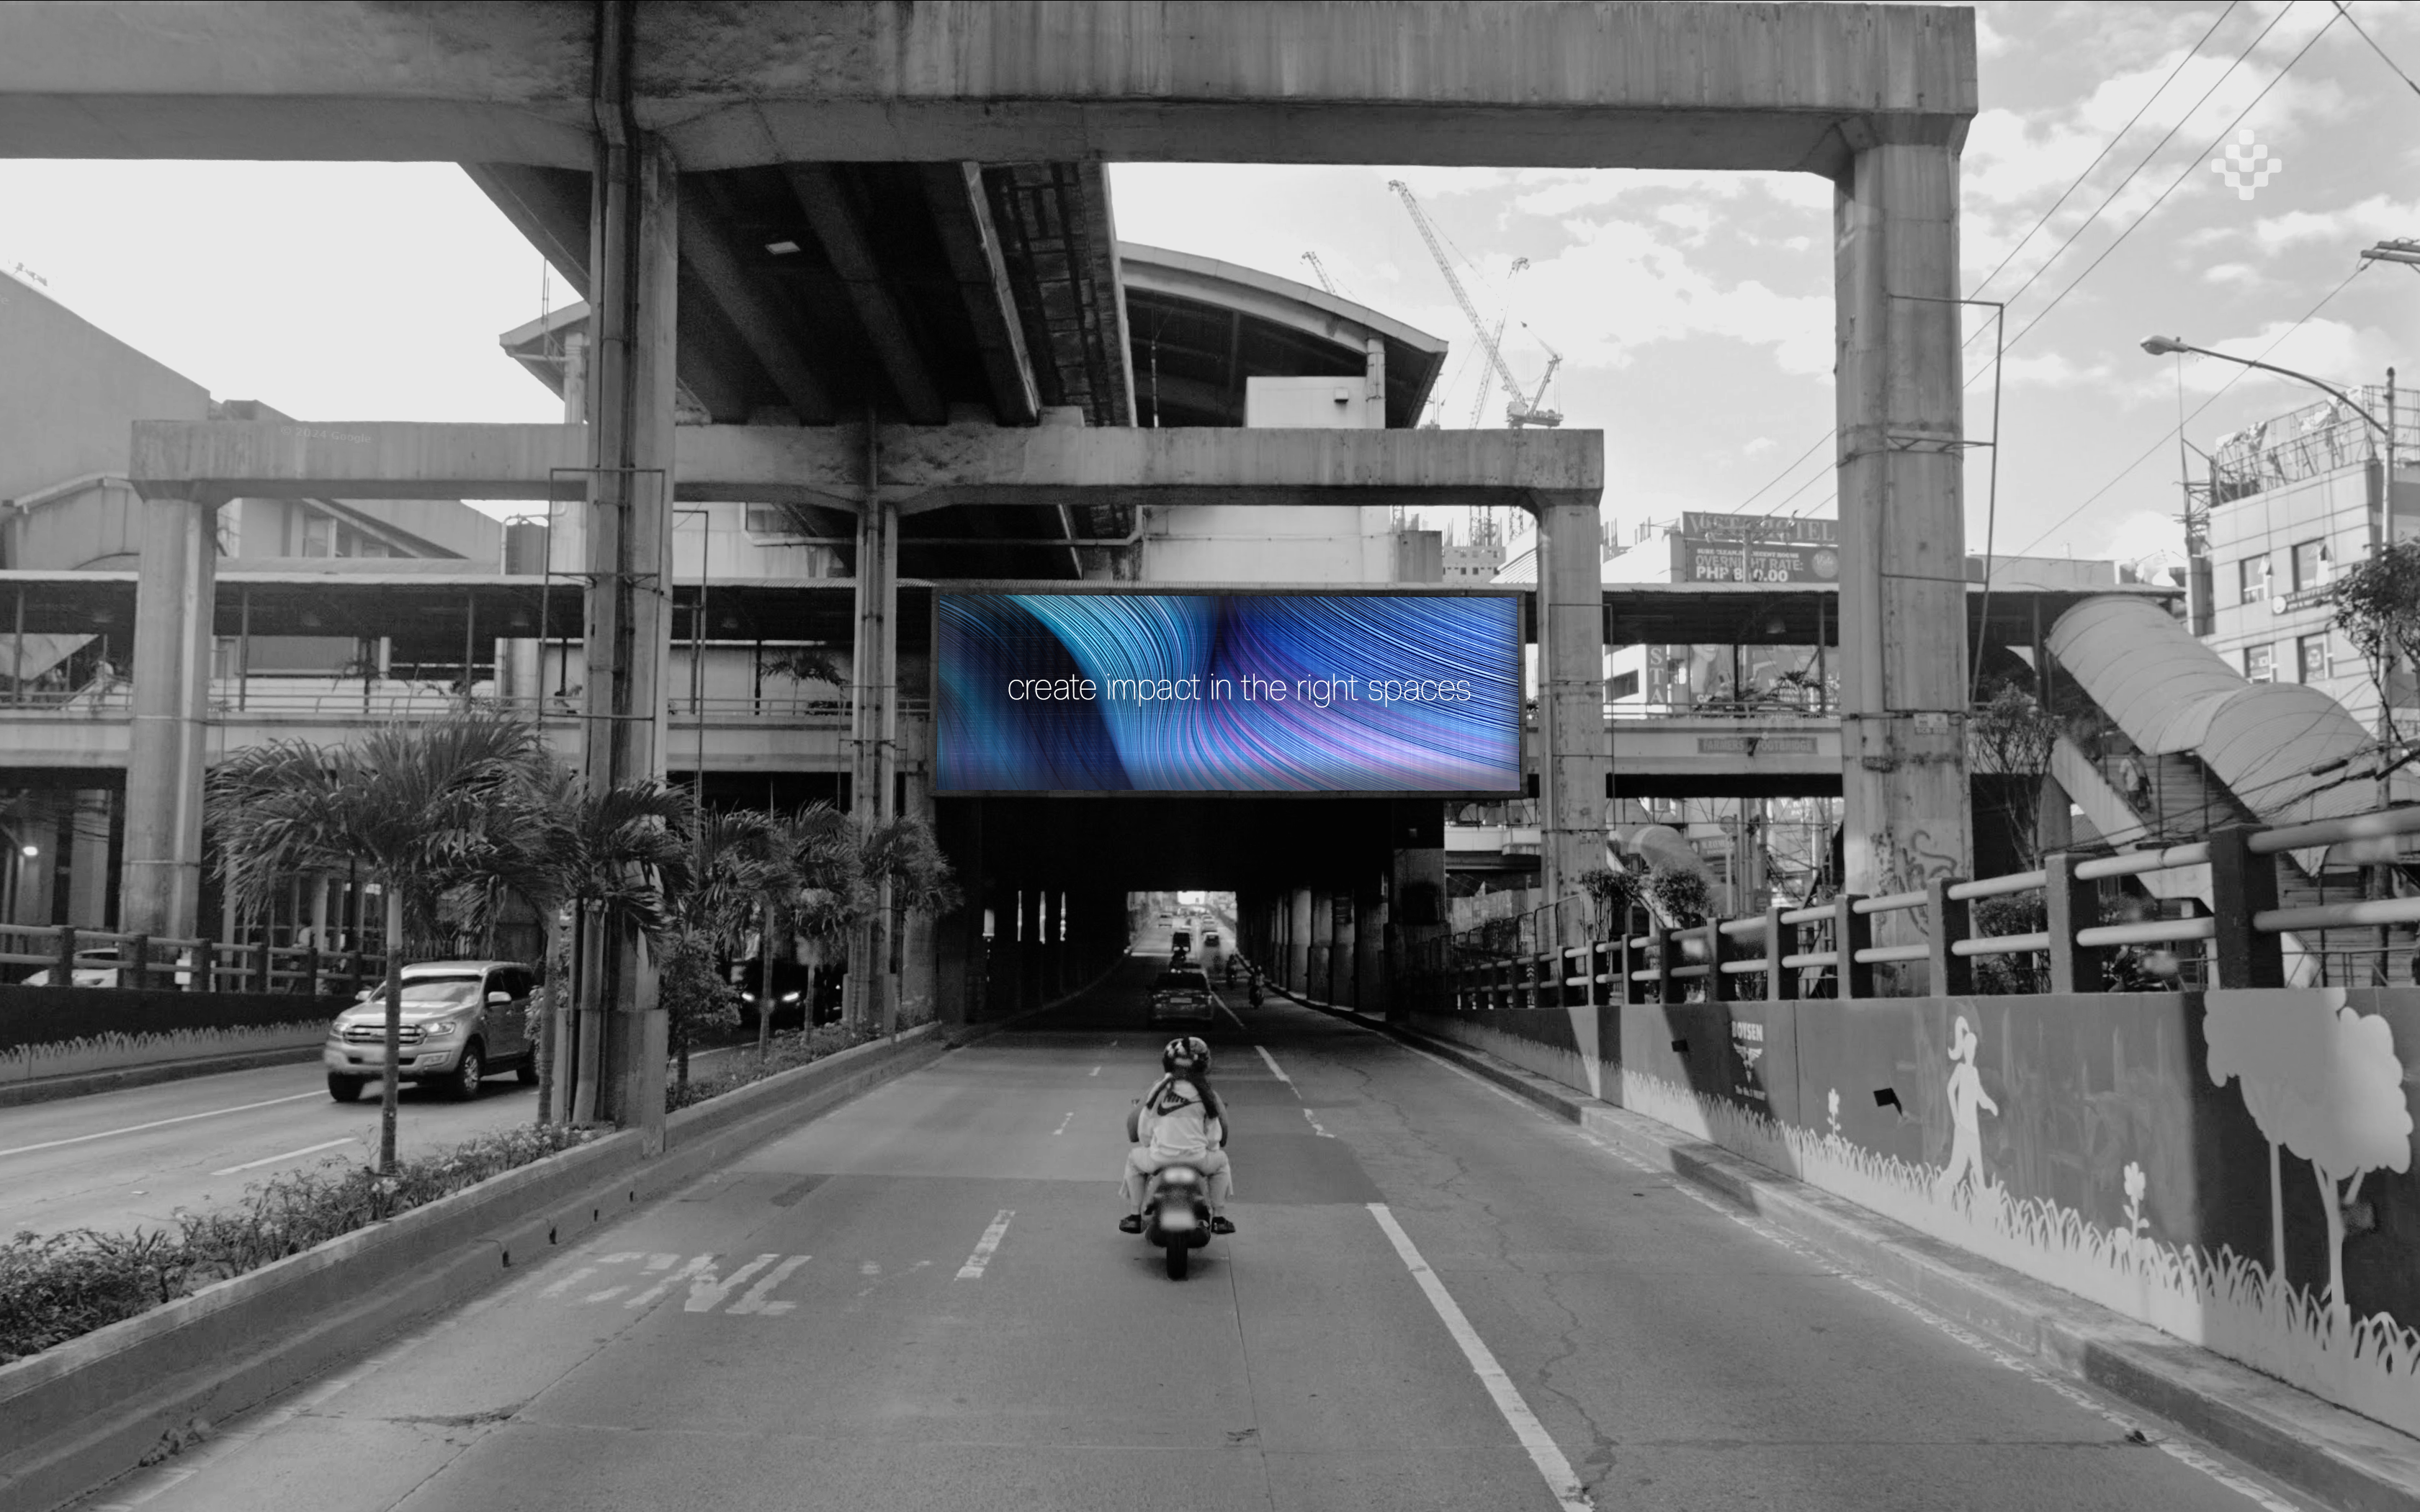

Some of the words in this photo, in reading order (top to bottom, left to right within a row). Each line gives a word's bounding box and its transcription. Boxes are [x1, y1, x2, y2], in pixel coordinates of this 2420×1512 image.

[1688, 514, 1754, 536] VIST
[1695, 555, 1765, 570] OVERNIHT
[1769, 558, 1803, 571] RATE:
[1696, 566, 1729, 579] PHP
[1734, 567, 1788, 582] 80.00
[1008, 674, 1095, 700] create
[1107, 673, 1200, 707] impact
[1211, 673, 1231, 699] in
[1240, 674, 1286, 701] the
[1297, 674, 1358, 708] right
[1368, 678, 1471, 707] spaces
[1731, 1020, 1763, 1042] BOYSEN
